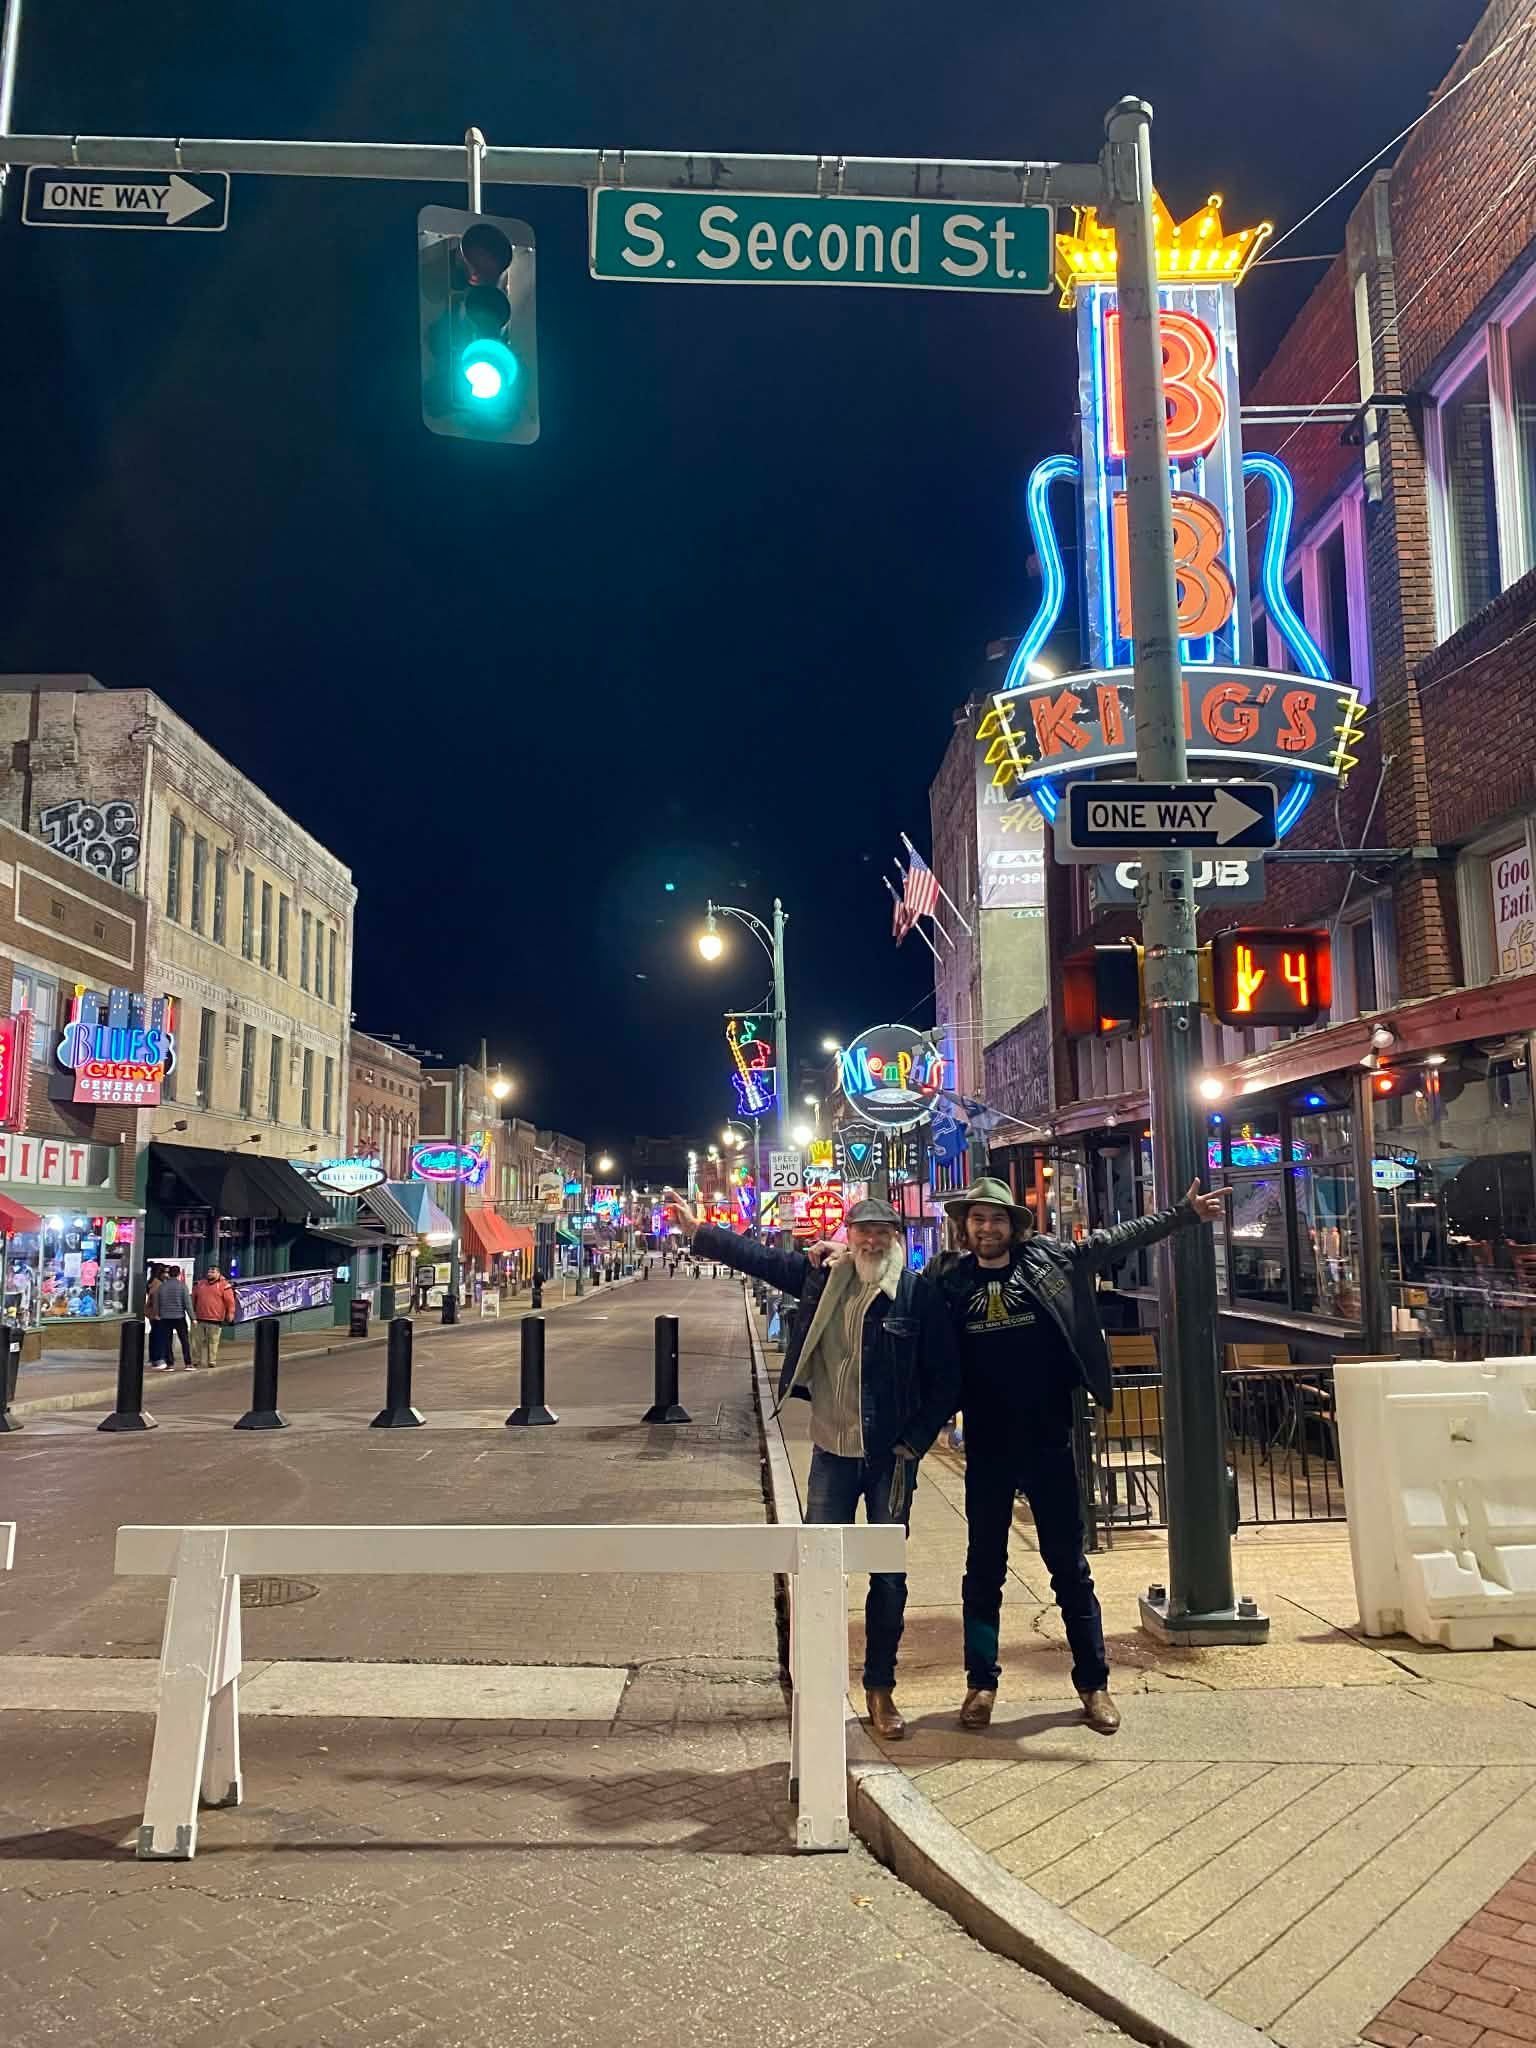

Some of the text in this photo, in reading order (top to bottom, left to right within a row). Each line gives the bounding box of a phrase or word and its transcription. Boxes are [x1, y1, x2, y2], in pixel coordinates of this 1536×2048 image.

[51, 186, 170, 210] ONE WAY
[620, 202, 1027, 279] S. Second St.
[1028, 680, 1318, 756] KIG'S
[1092, 804, 1213, 828] ONE WAY
[1114, 860, 1250, 890] CUB
[1500, 885, 1534, 923] Eati
[1283, 952, 1308, 1006] 4
[74, 1023, 162, 1067] BLUES
[87, 1062, 162, 1081] CITY
[80, 1079, 155, 1093] GENERAL
[92, 1092, 143, 1103] STORE
[773, 1155, 799, 1163] SPEED
[775, 1163, 797, 1171] LIMIT
[773, 1171, 799, 1187] 20
